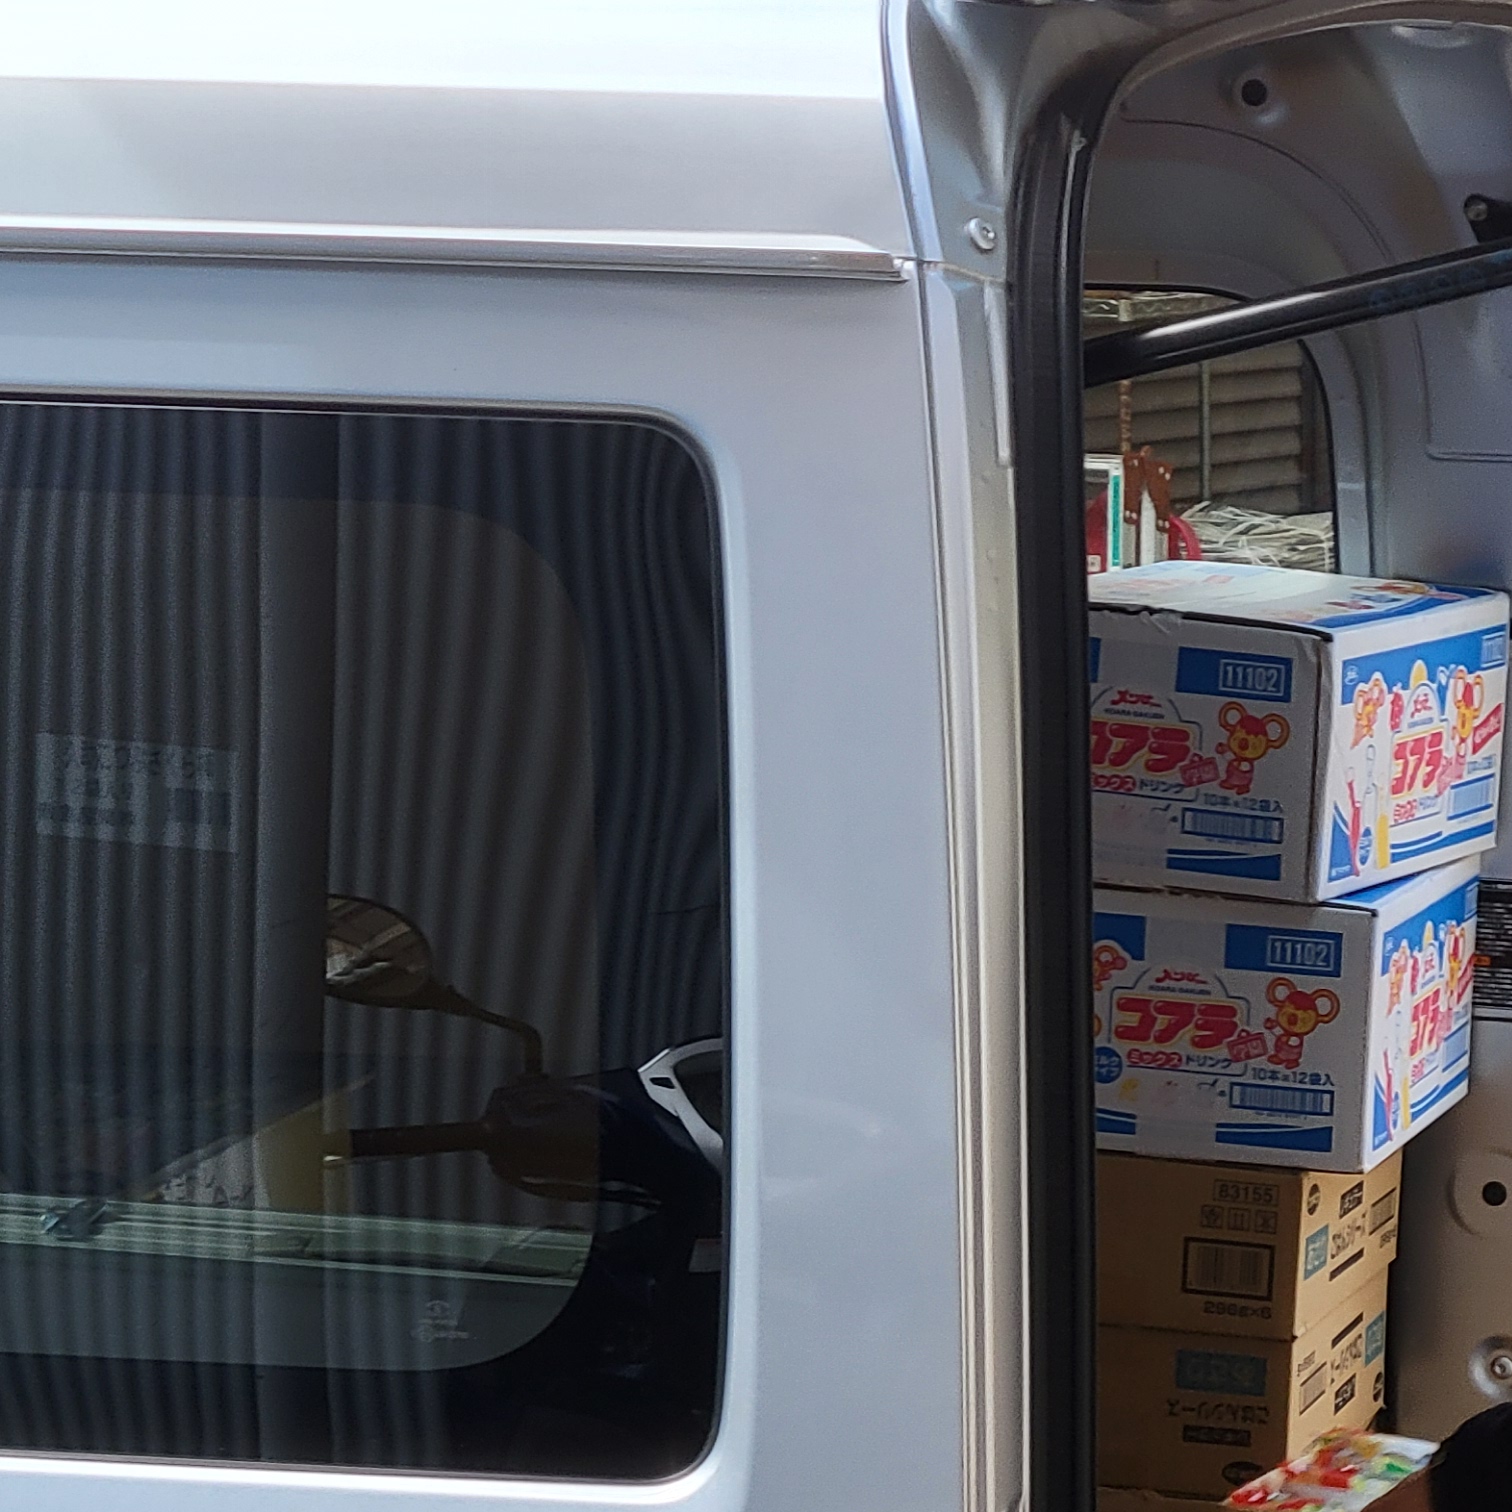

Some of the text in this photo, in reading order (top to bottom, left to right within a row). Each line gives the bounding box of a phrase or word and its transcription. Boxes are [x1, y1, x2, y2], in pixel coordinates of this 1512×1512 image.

[1225, 665, 1278, 692] 11102
[1274, 940, 1328, 970] 11102
[1115, 997, 1239, 1049] コアラ
[1218, 1183, 1274, 1203] 83155
